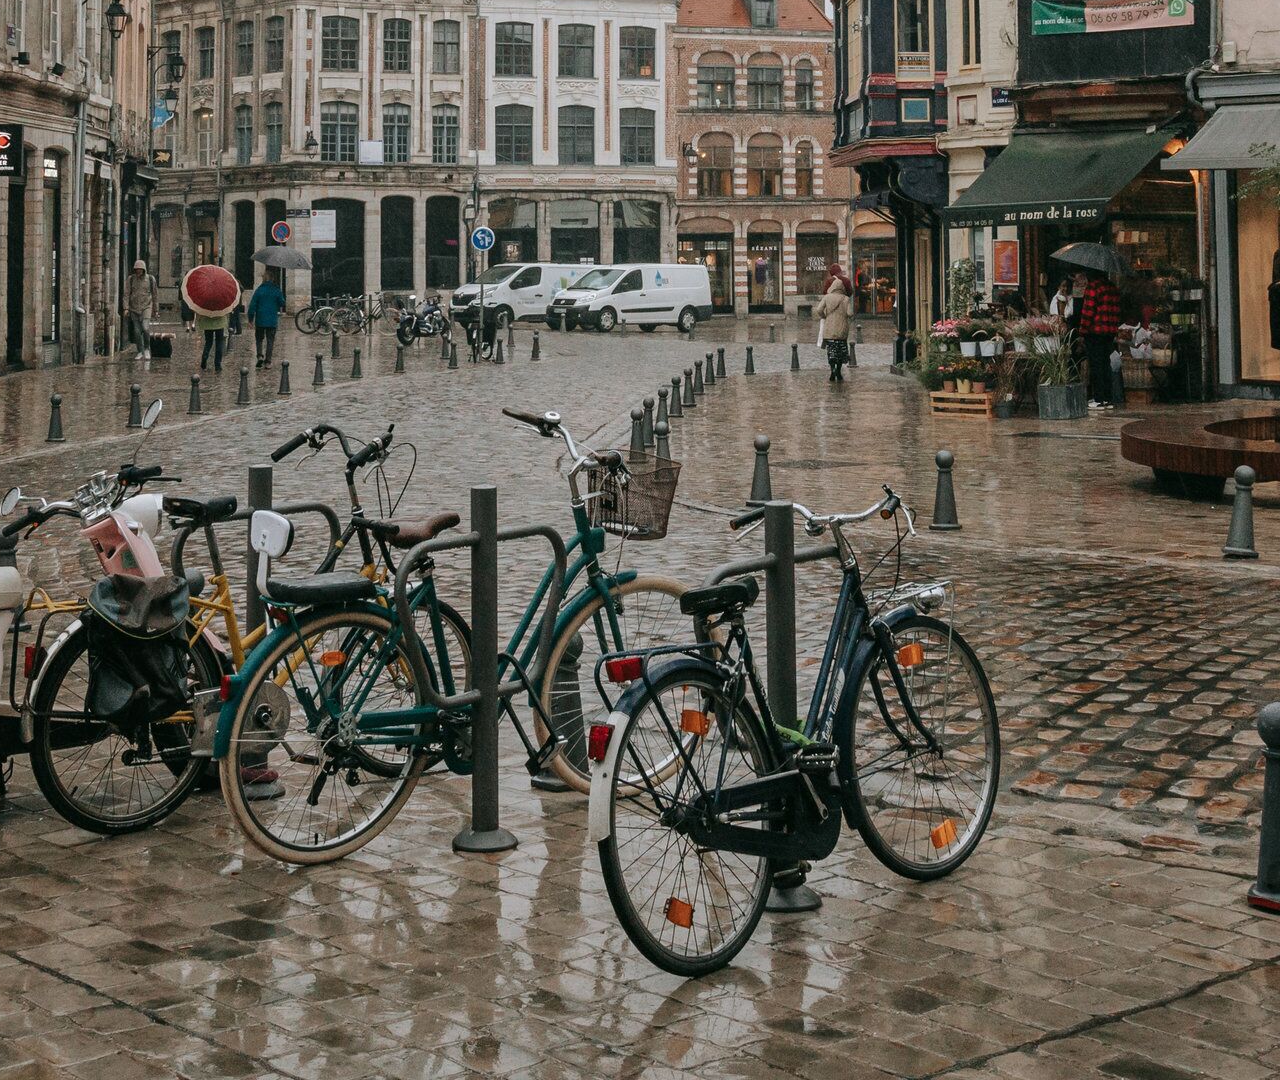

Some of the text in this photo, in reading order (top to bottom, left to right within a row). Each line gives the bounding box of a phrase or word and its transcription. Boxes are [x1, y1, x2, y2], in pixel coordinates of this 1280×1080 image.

[1057, 16, 1065, 24] de
[1091, 7, 1165, 24] 06 69 58 79 57
[1004, 205, 1098, 221] au nom de la rose
